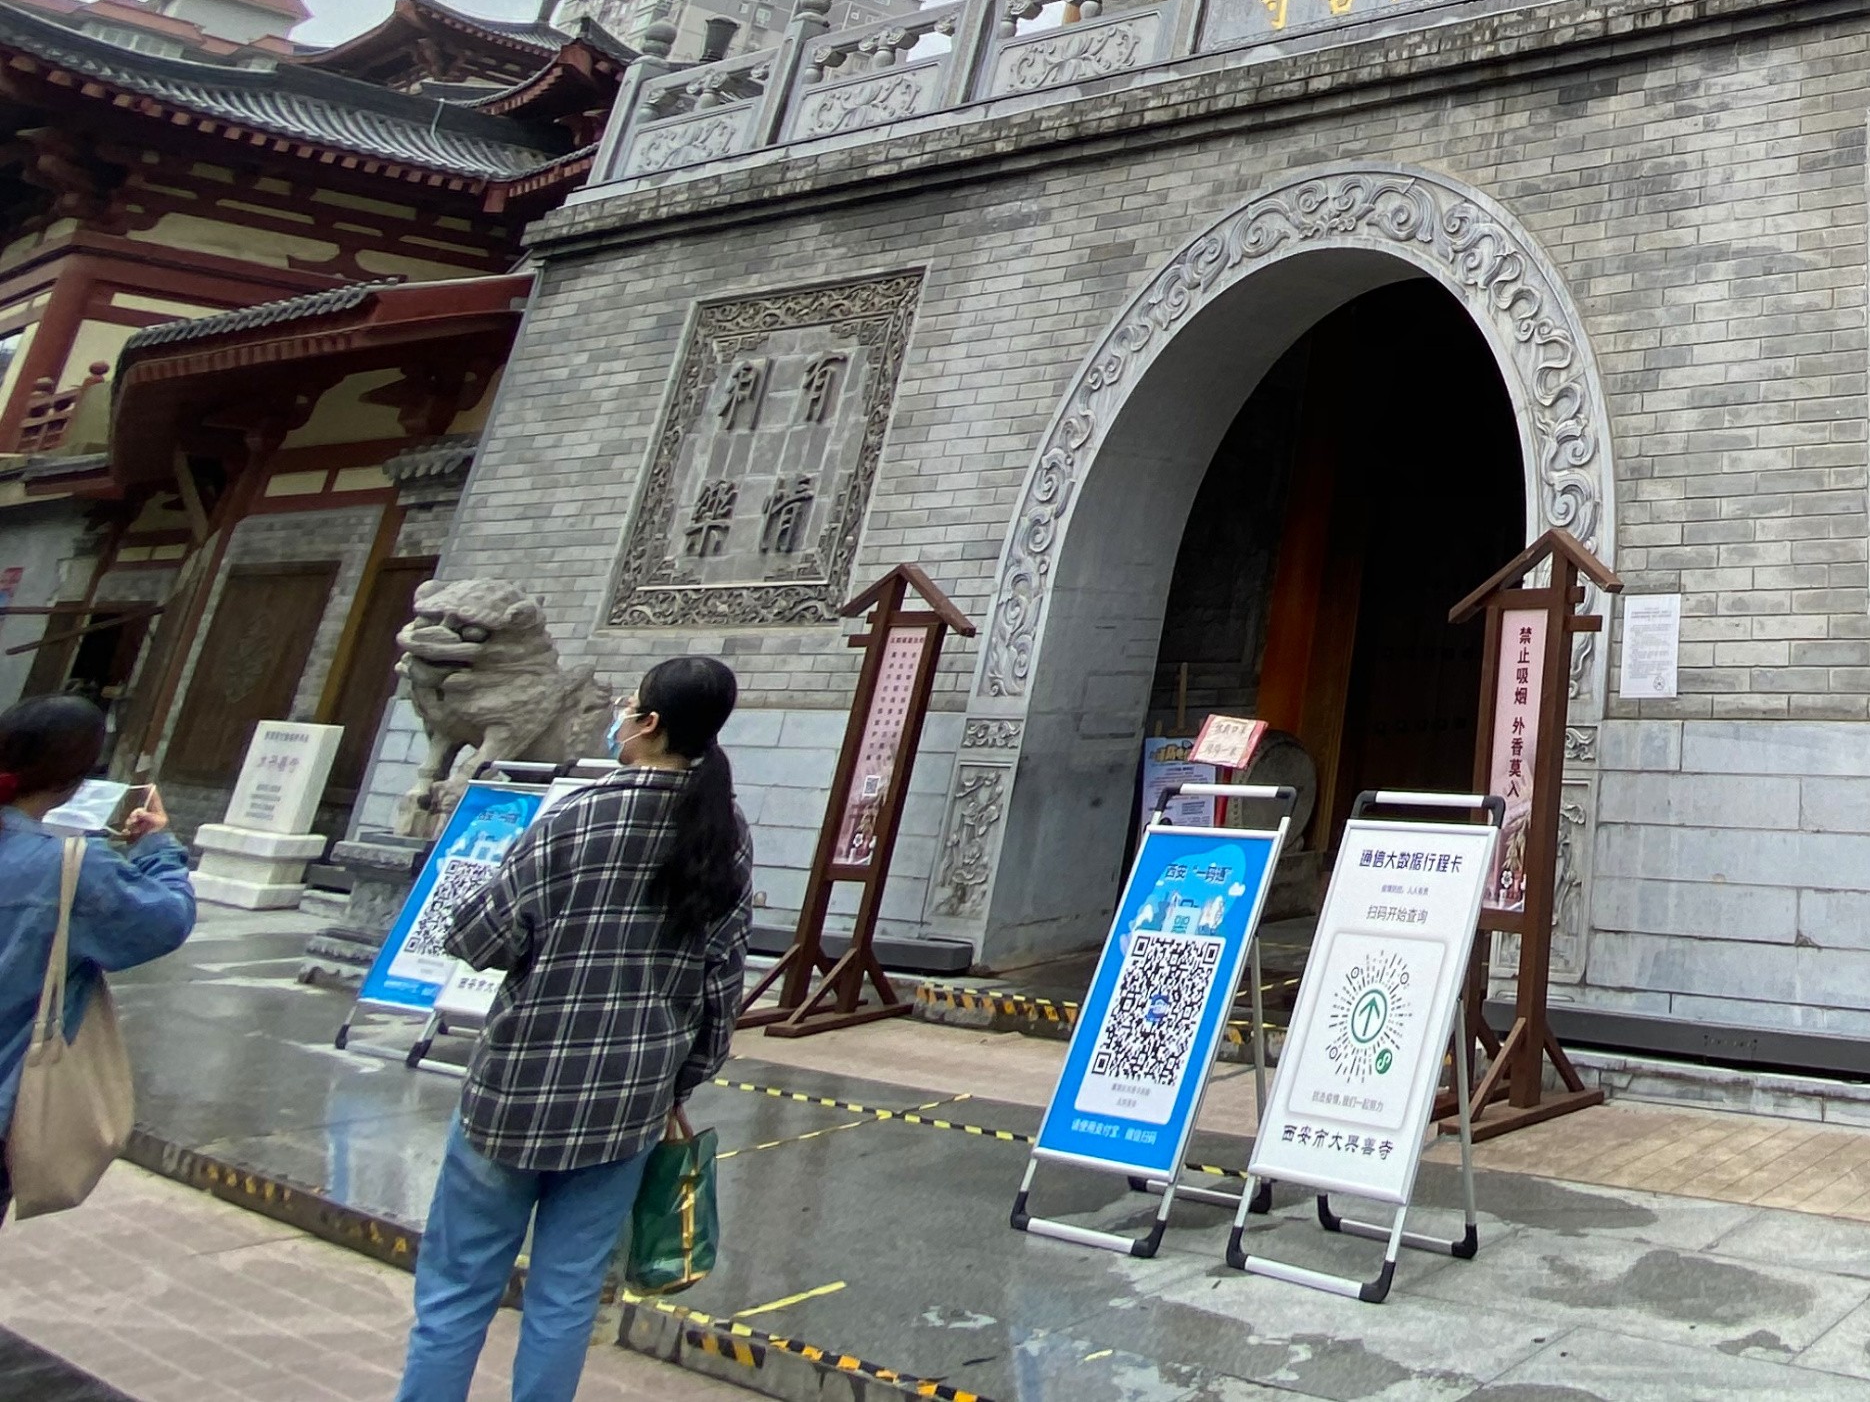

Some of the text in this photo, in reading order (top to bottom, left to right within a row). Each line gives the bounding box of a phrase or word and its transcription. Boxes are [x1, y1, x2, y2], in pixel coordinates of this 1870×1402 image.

[1359, 849, 1463, 873] 通信大数据行程卡
[1366, 905, 1428, 924] 扫码开始查询
